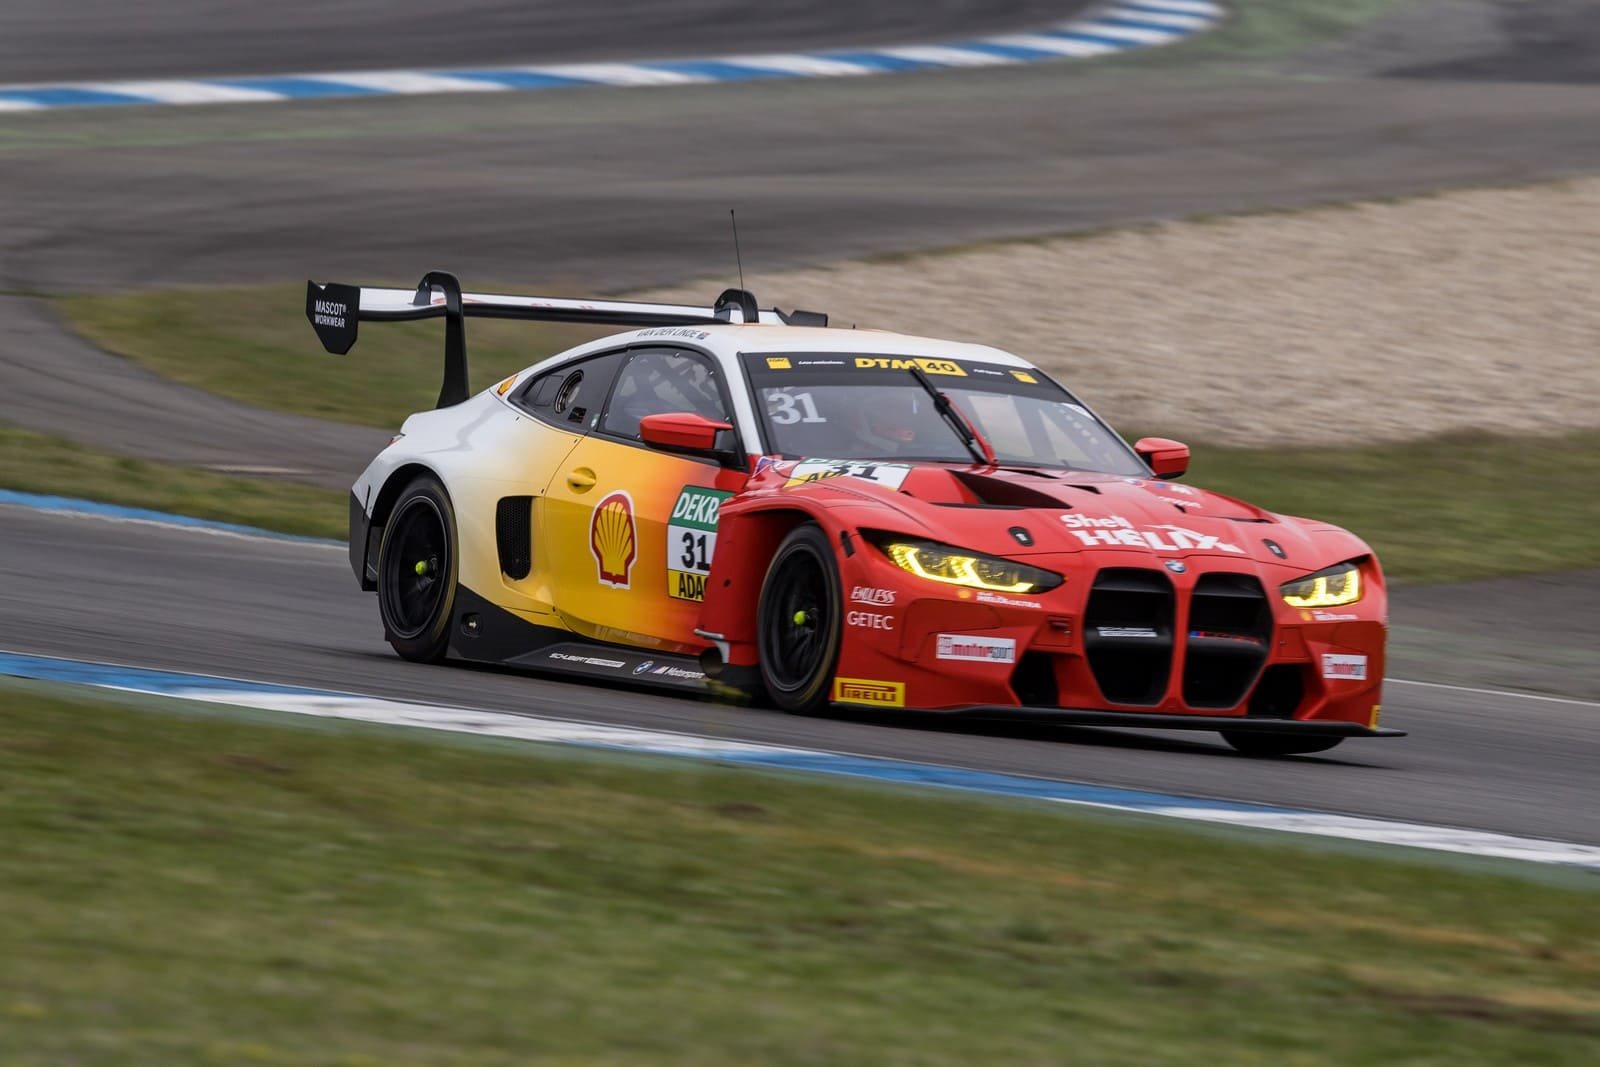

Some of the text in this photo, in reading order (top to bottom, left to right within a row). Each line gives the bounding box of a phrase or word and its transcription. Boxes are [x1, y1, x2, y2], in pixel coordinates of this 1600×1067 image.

[315, 314, 345, 329] WORKWEAR
[854, 358, 920, 370] DTM
[926, 362, 957, 373] 40
[768, 392, 827, 425] 31
[672, 492, 720, 525] DEKR
[1059, 513, 1134, 529] Shell
[1068, 524, 1248, 554] HELIX
[681, 532, 711, 572] 31
[851, 586, 896, 604] ENDLESS
[847, 611, 894, 630] GETEC
[840, 682, 897, 702] PIRELLI
